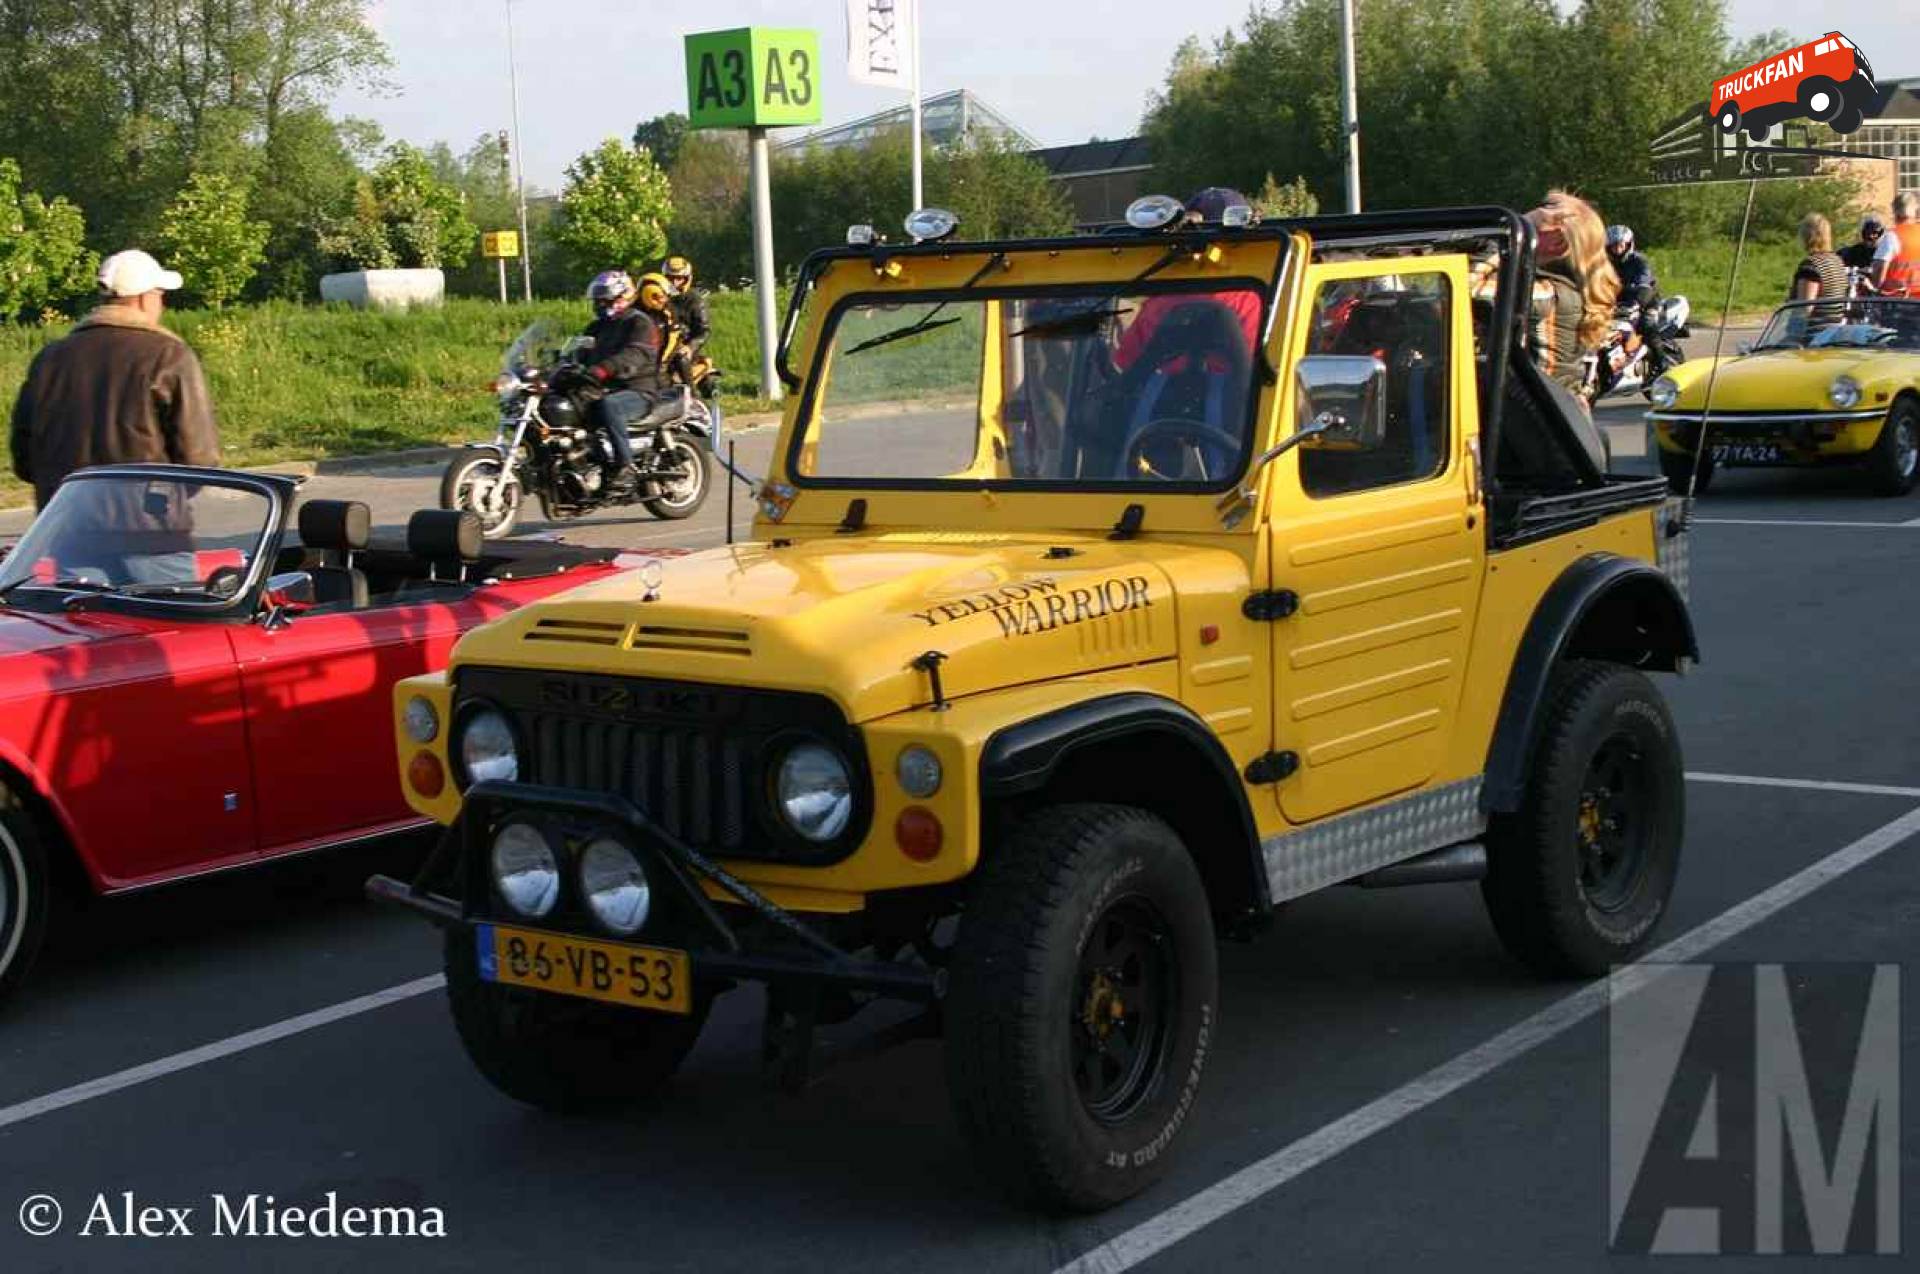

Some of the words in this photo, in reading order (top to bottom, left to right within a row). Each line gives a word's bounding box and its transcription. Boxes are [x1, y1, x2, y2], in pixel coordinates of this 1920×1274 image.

[696, 50, 746, 110] A3
[763, 47, 812, 106] A3
[912, 577, 1057, 626] YELLOW
[991, 574, 1152, 638] WARRIOR
[539, 680, 717, 713] SUZUKI
[508, 936, 674, 1000] 86-VB-53
